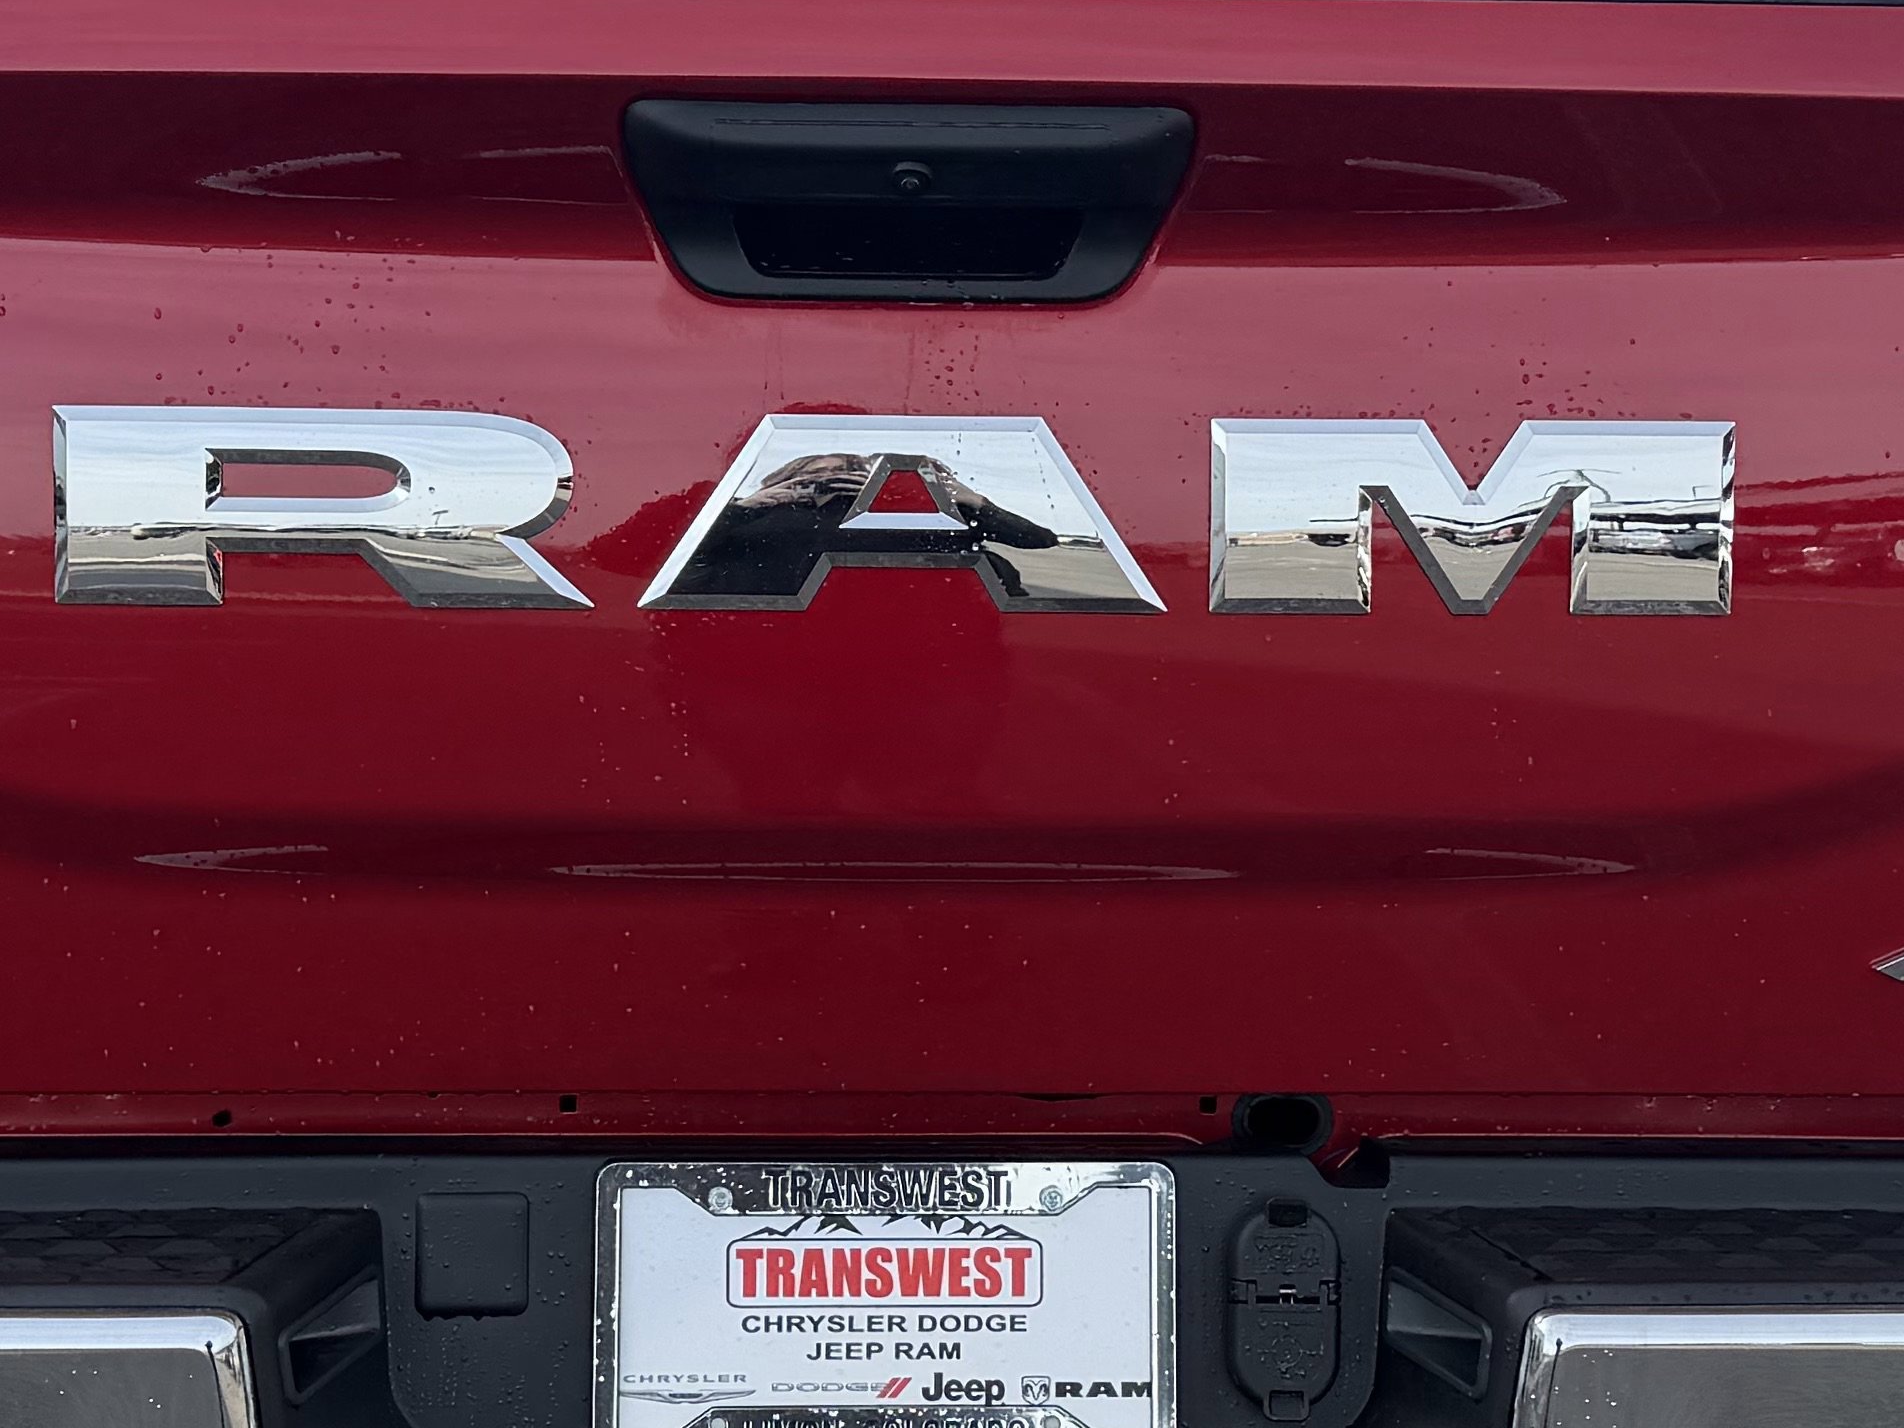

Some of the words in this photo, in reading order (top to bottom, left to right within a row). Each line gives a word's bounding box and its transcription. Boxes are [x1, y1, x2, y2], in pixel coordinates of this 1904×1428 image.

[53, 404, 1738, 615] RAM
[762, 1168, 1010, 1209] TRANSWEST
[735, 1246, 1033, 1299] TRANSWEST
[741, 1314, 908, 1333] CHRYSLER
[917, 1314, 1028, 1333] DODGE
[806, 1342, 884, 1361] JEEP
[894, 1341, 962, 1360] RAM
[623, 1374, 747, 1384] CHRYSLER
[771, 1382, 887, 1392] DODGE
[921, 1372, 1006, 1406] Jeep
[1054, 1381, 1152, 1398] RAM
